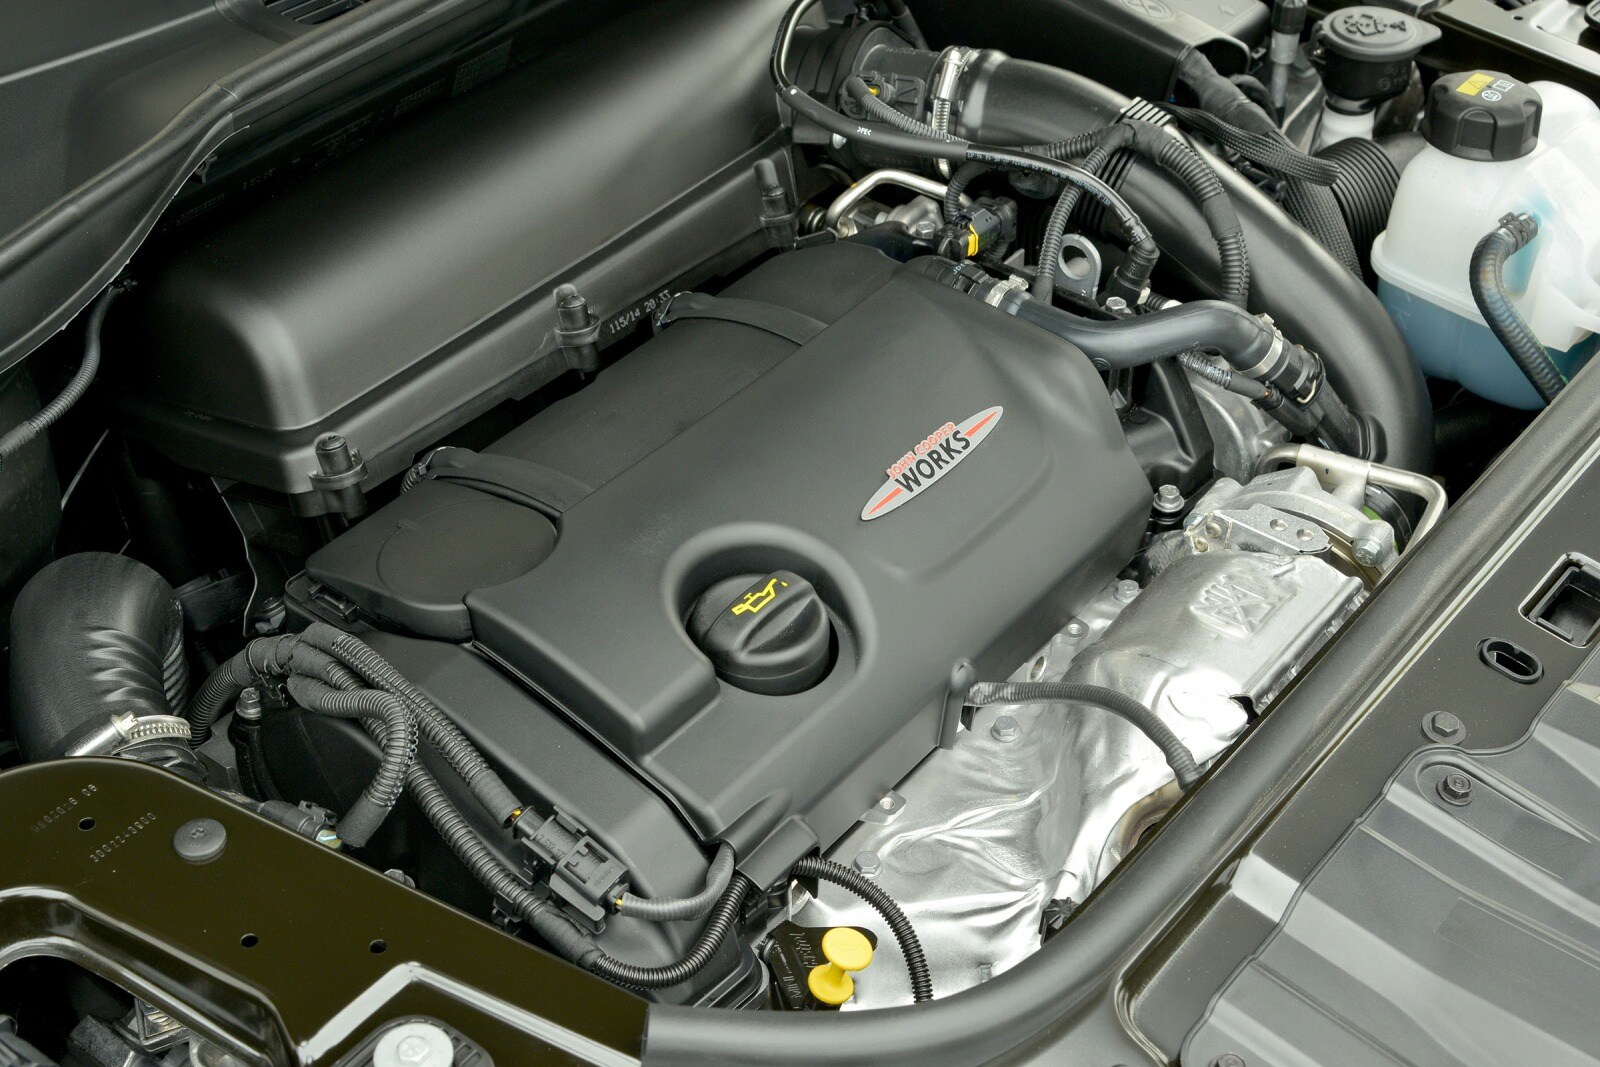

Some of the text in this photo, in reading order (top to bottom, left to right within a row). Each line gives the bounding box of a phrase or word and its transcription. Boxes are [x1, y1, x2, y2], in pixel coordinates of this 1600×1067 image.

[886, 421, 956, 480] JOHN COOPER
[894, 430, 971, 493] WORKS
